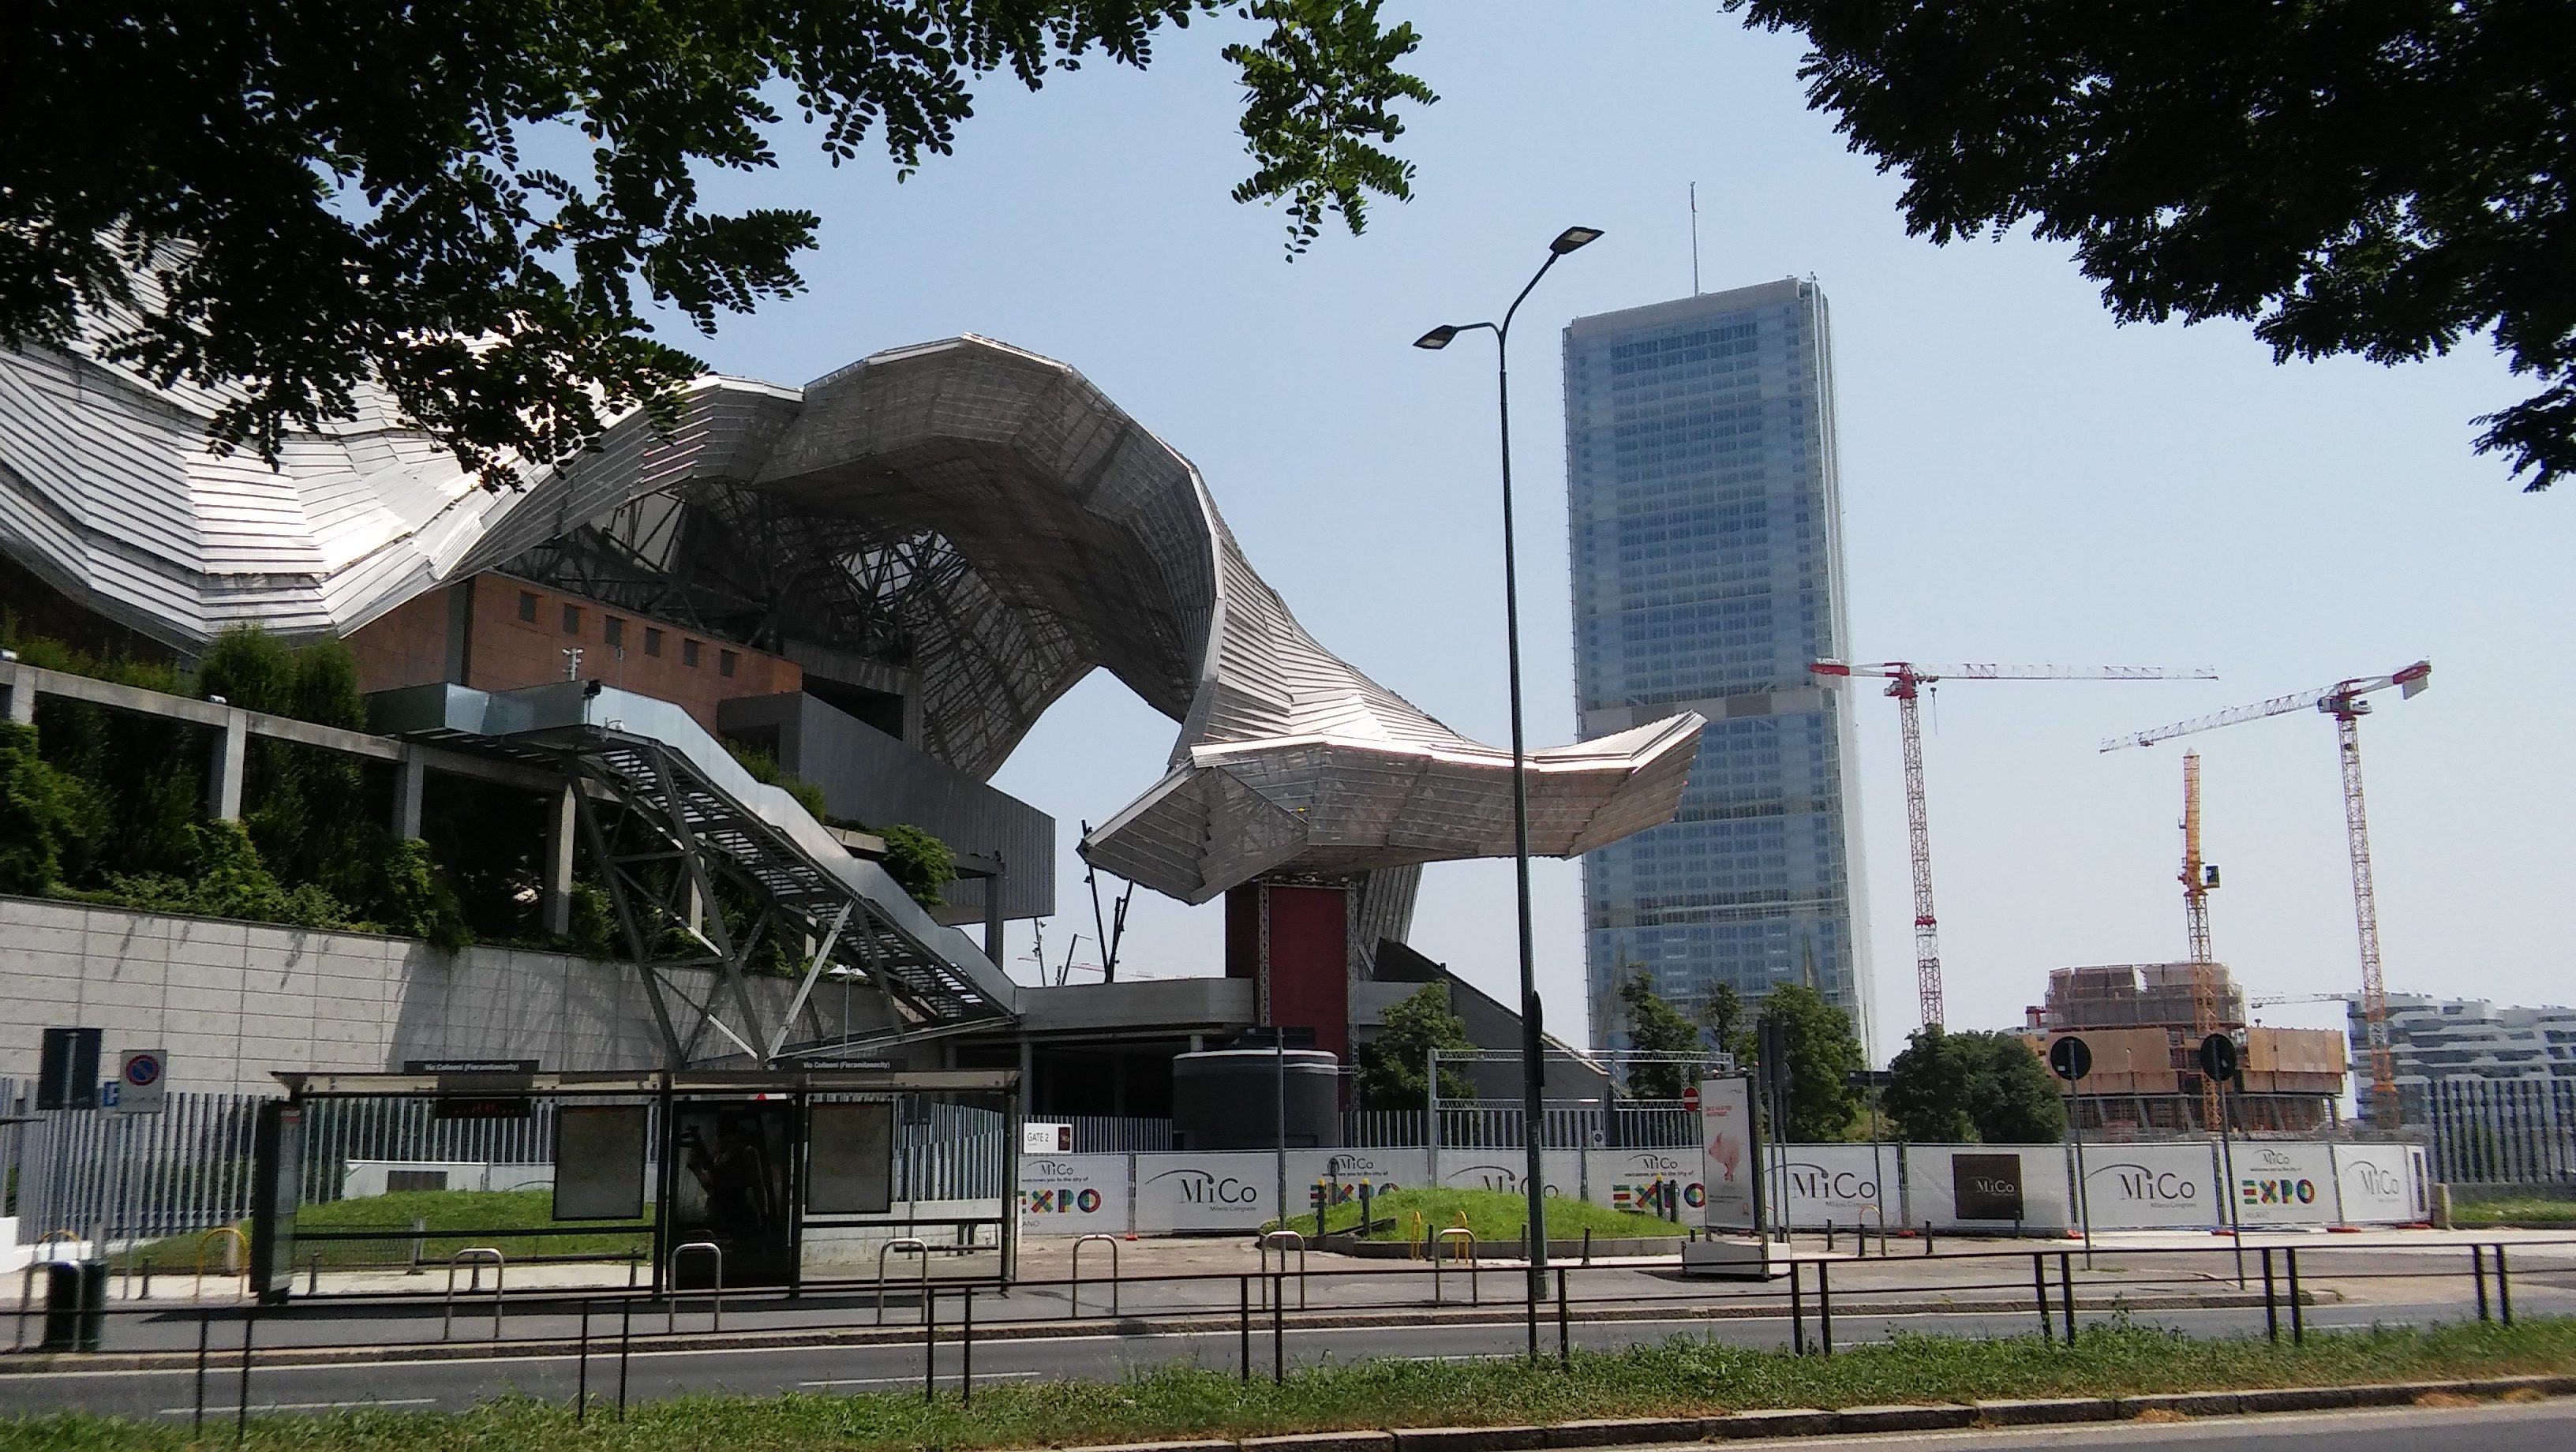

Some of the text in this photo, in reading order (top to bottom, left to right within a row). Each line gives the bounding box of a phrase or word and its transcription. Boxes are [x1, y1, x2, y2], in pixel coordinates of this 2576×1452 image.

[1027, 1132, 1043, 1143] GATE
[1045, 1133, 1050, 1143] 2
[1040, 1162, 1074, 1176] MiCo
[1339, 1156, 1374, 1169] MiCo
[1642, 1156, 1678, 1169] MiCo
[1178, 1174, 1257, 1203] MiCo
[1790, 1169, 1876, 1199] MiCo
[1976, 1179, 2015, 1193] MiCo
[2117, 1171, 2196, 1199] MiCo
[2241, 1178, 2316, 1205] EXPO
[2360, 1169, 2398, 1195] MiCo
